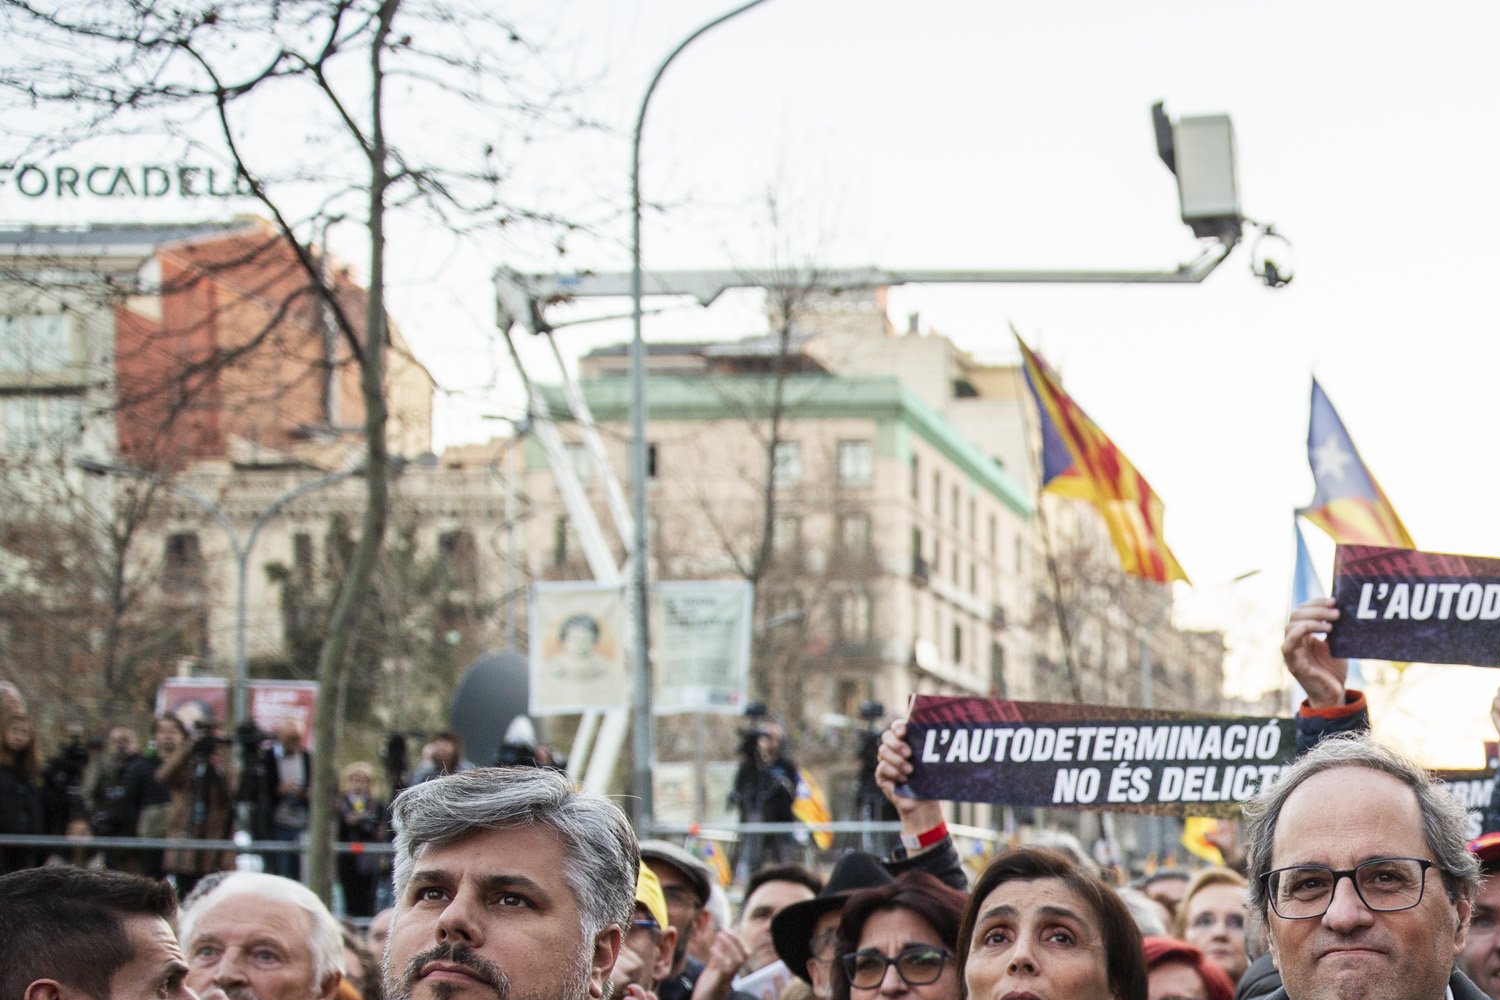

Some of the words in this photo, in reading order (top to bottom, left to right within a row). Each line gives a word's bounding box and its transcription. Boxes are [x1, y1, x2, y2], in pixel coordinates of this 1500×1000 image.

[921, 718, 1282, 763] L'AUTODETERMINACIÓ
[1052, 767, 1102, 804] NO
[1107, 762, 1151, 802] ÉS
[1157, 765, 1292, 802] DELICT
